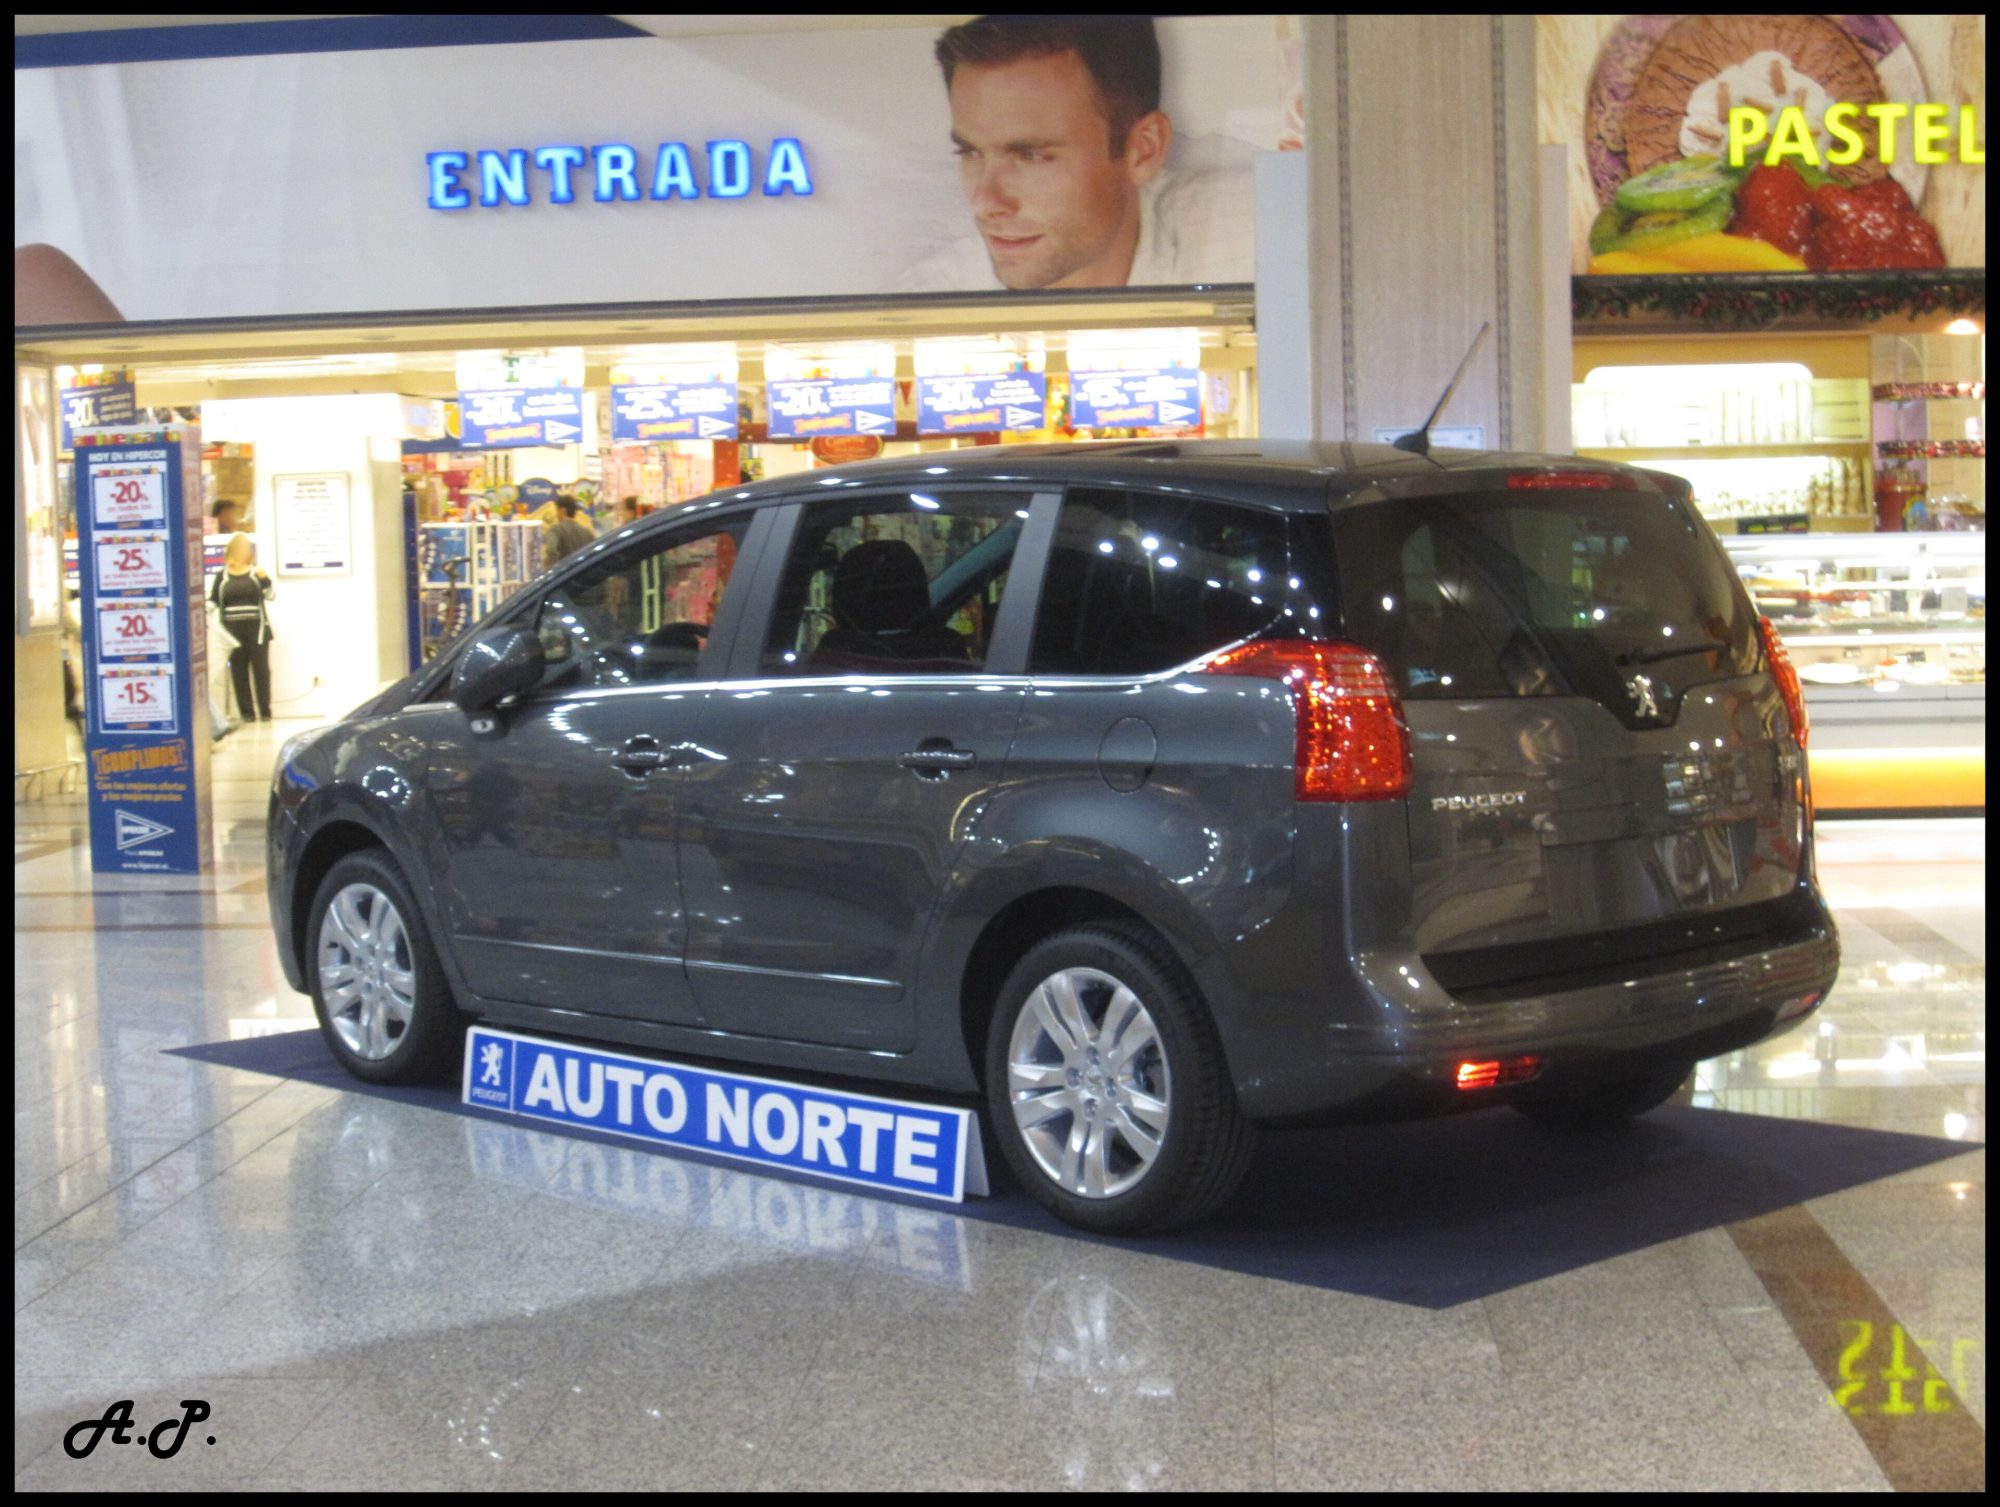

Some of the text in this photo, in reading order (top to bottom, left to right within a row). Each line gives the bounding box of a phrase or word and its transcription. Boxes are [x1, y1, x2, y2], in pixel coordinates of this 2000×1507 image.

[1729, 102, 1985, 166] PASTEL
[426, 137, 813, 210] ENTRADA
[1431, 790, 1526, 811] PEUGEOT
[472, 1086, 507, 1103] PEUGEOT
[524, 1053, 941, 1185] AUTO NORTE
